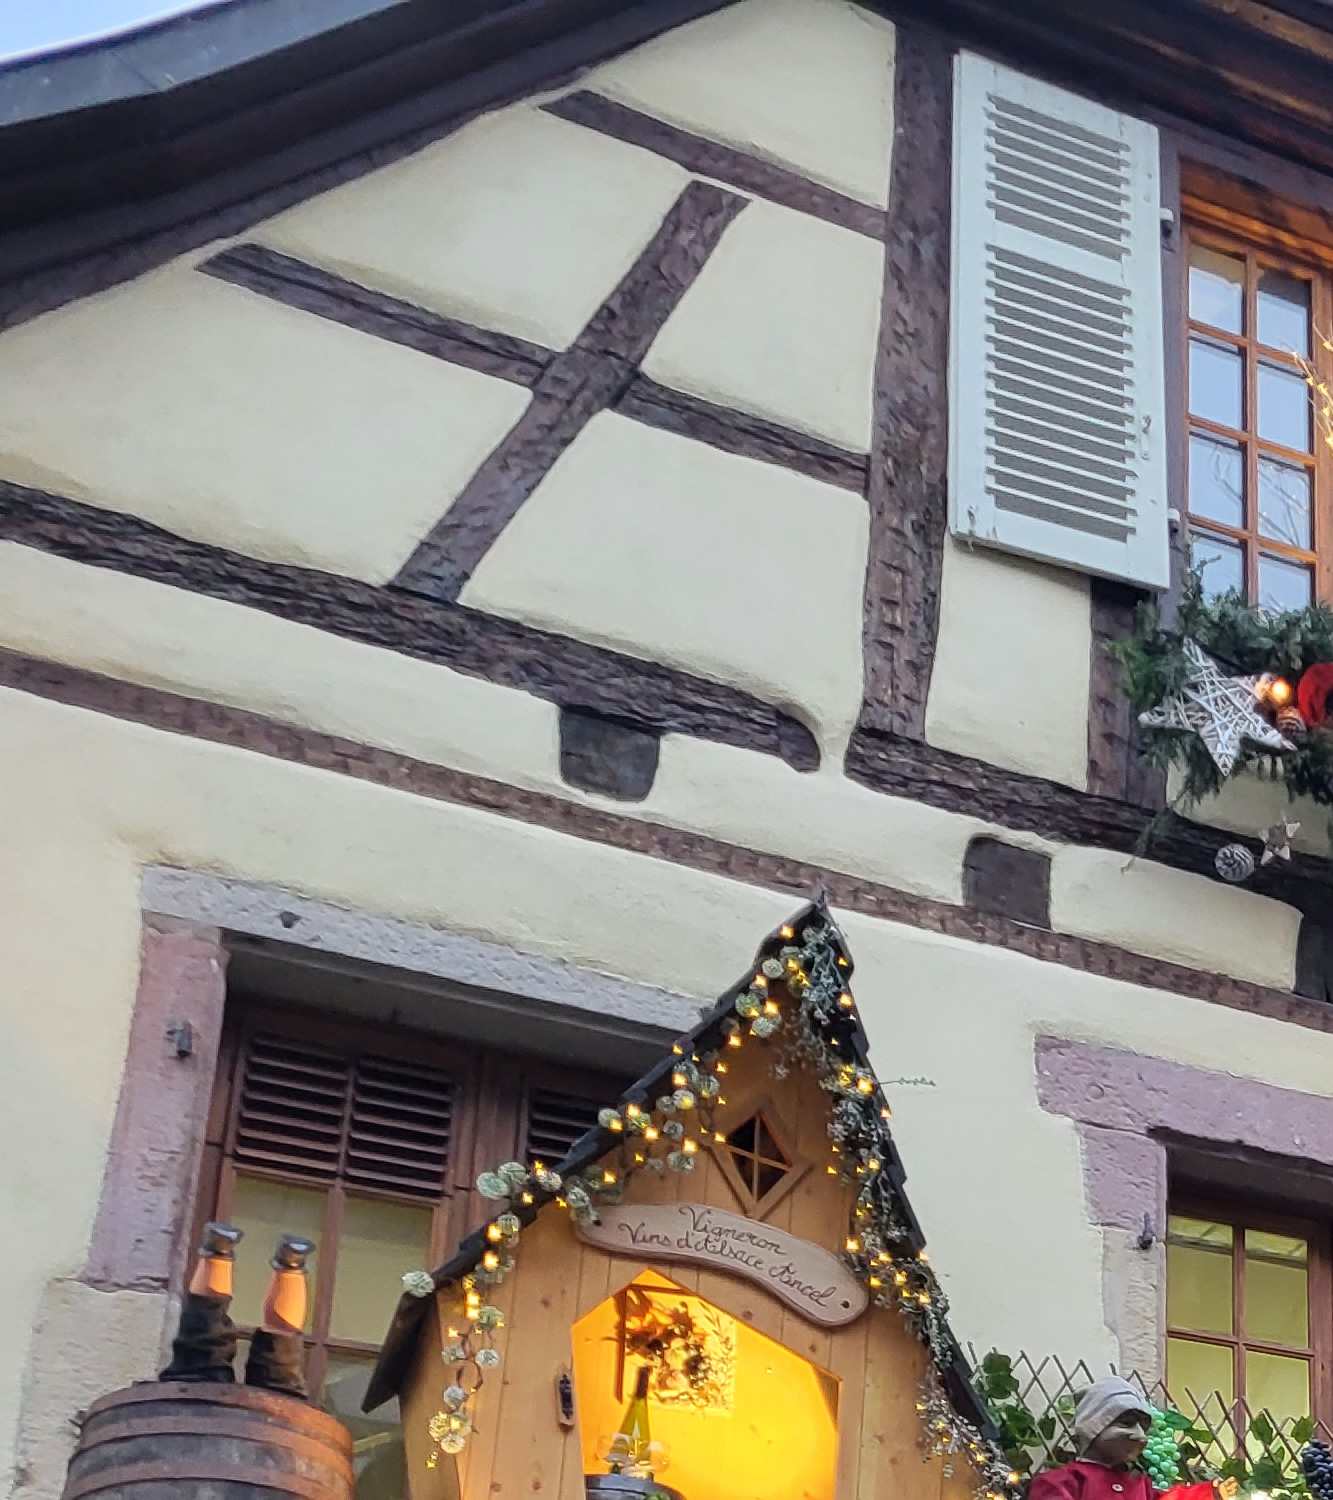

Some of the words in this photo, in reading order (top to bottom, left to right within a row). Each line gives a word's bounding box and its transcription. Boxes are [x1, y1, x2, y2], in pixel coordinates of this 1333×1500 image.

[618, 1222, 671, 1247] Vins
[676, 1230, 765, 1271] d'Alsace
[679, 1205, 789, 1256] Vigneron
